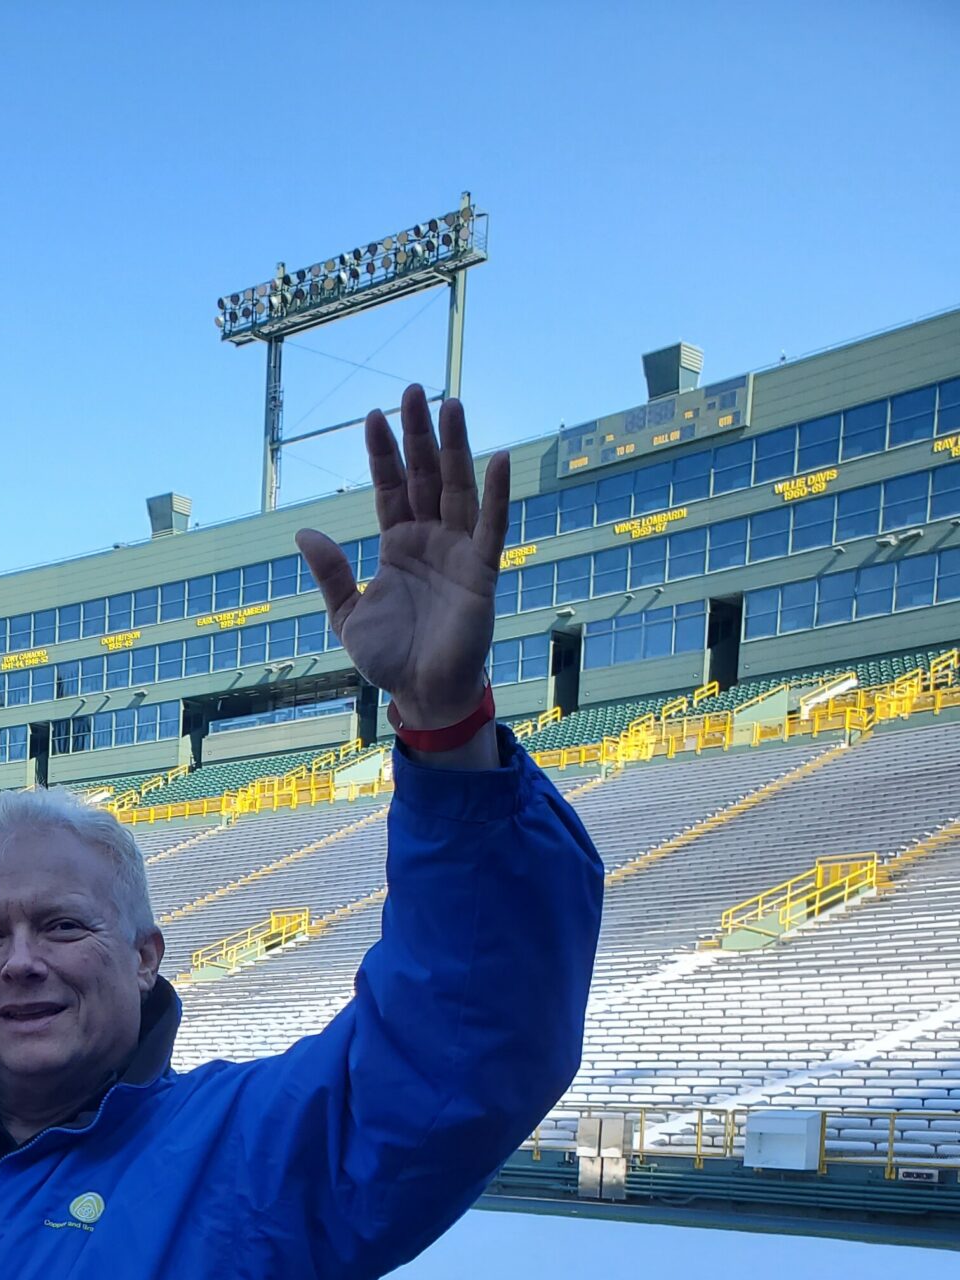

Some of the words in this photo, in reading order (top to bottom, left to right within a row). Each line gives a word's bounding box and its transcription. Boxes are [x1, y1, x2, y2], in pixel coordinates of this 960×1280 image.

[933, 436, 956, 453] RAY
[774, 477, 806, 494] WILLIE
[807, 469, 838, 486] DAVIS
[784, 481, 827, 501] 1960-69
[614, 519, 640, 534] VINCE
[641, 507, 688, 527] LOMBARDI
[632, 521, 668, 539] 1959-67
[238, 603, 271, 617] LAMBEAU
